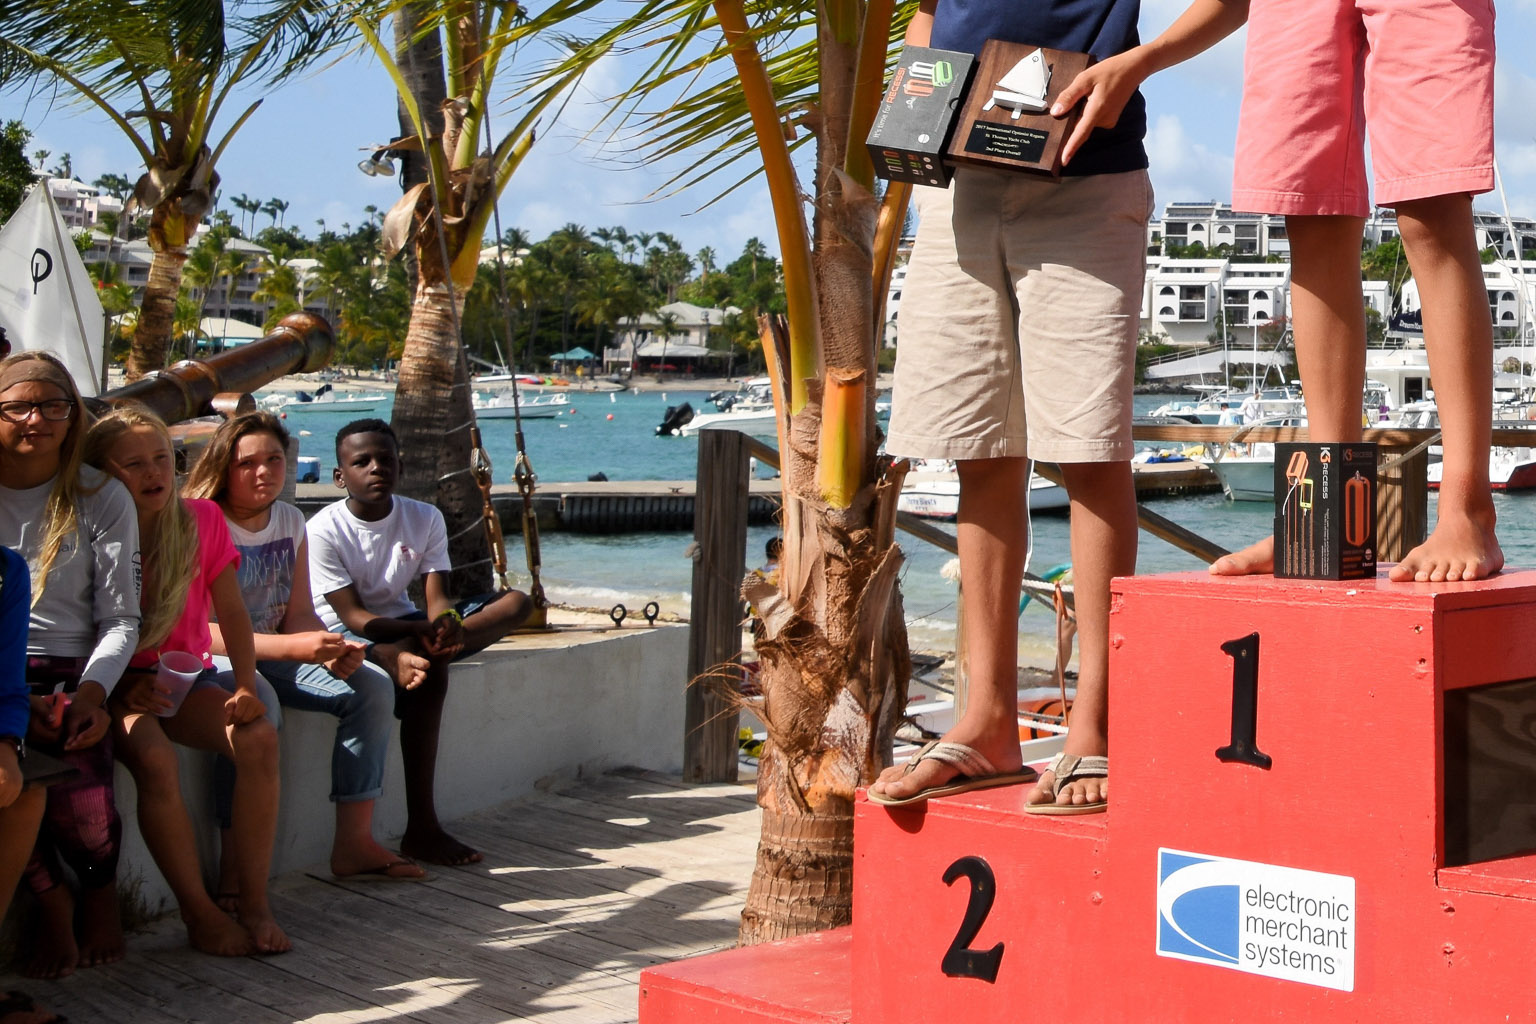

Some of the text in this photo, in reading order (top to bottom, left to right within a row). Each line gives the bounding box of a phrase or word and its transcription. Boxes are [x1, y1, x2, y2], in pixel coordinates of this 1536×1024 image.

[243, 549, 292, 589] DREAM
[1215, 631, 1273, 771] 1
[941, 856, 1005, 984] 2
[1246, 884, 1349, 922] electronic
[1246, 915, 1348, 950] merchant
[1245, 942, 1336, 975] systems
